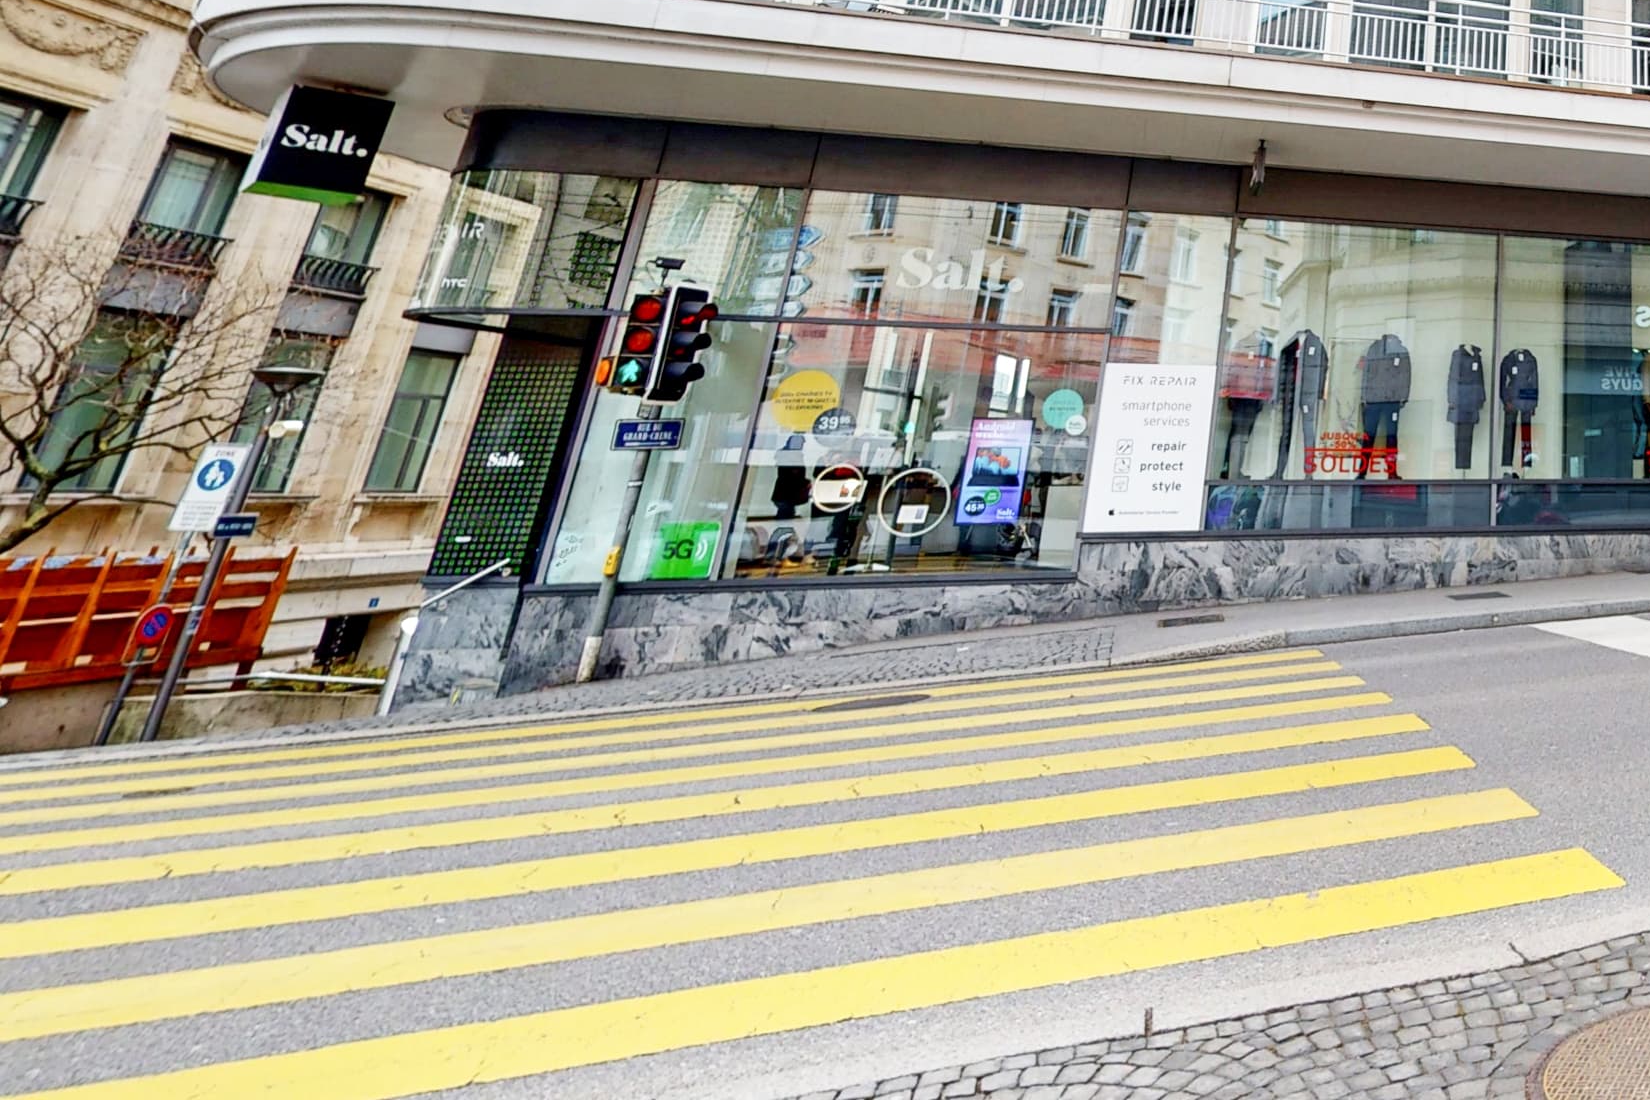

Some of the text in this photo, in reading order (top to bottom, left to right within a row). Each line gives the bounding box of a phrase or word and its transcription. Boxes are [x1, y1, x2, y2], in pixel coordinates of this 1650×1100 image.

[280, 123, 368, 158] Salt.
[896, 247, 1025, 293] Salt.
[1123, 375, 1198, 387] FIX REPAIR
[1121, 400, 1192, 416] smartphone
[1143, 416, 1191, 428] services
[1151, 441, 1187, 453] repair
[486, 451, 525, 467] Salt.
[1139, 461, 1184, 473] protect
[1304, 453, 1398, 474] SOLDES
[1151, 480, 1182, 493] style
[662, 539, 695, 560] 5G
